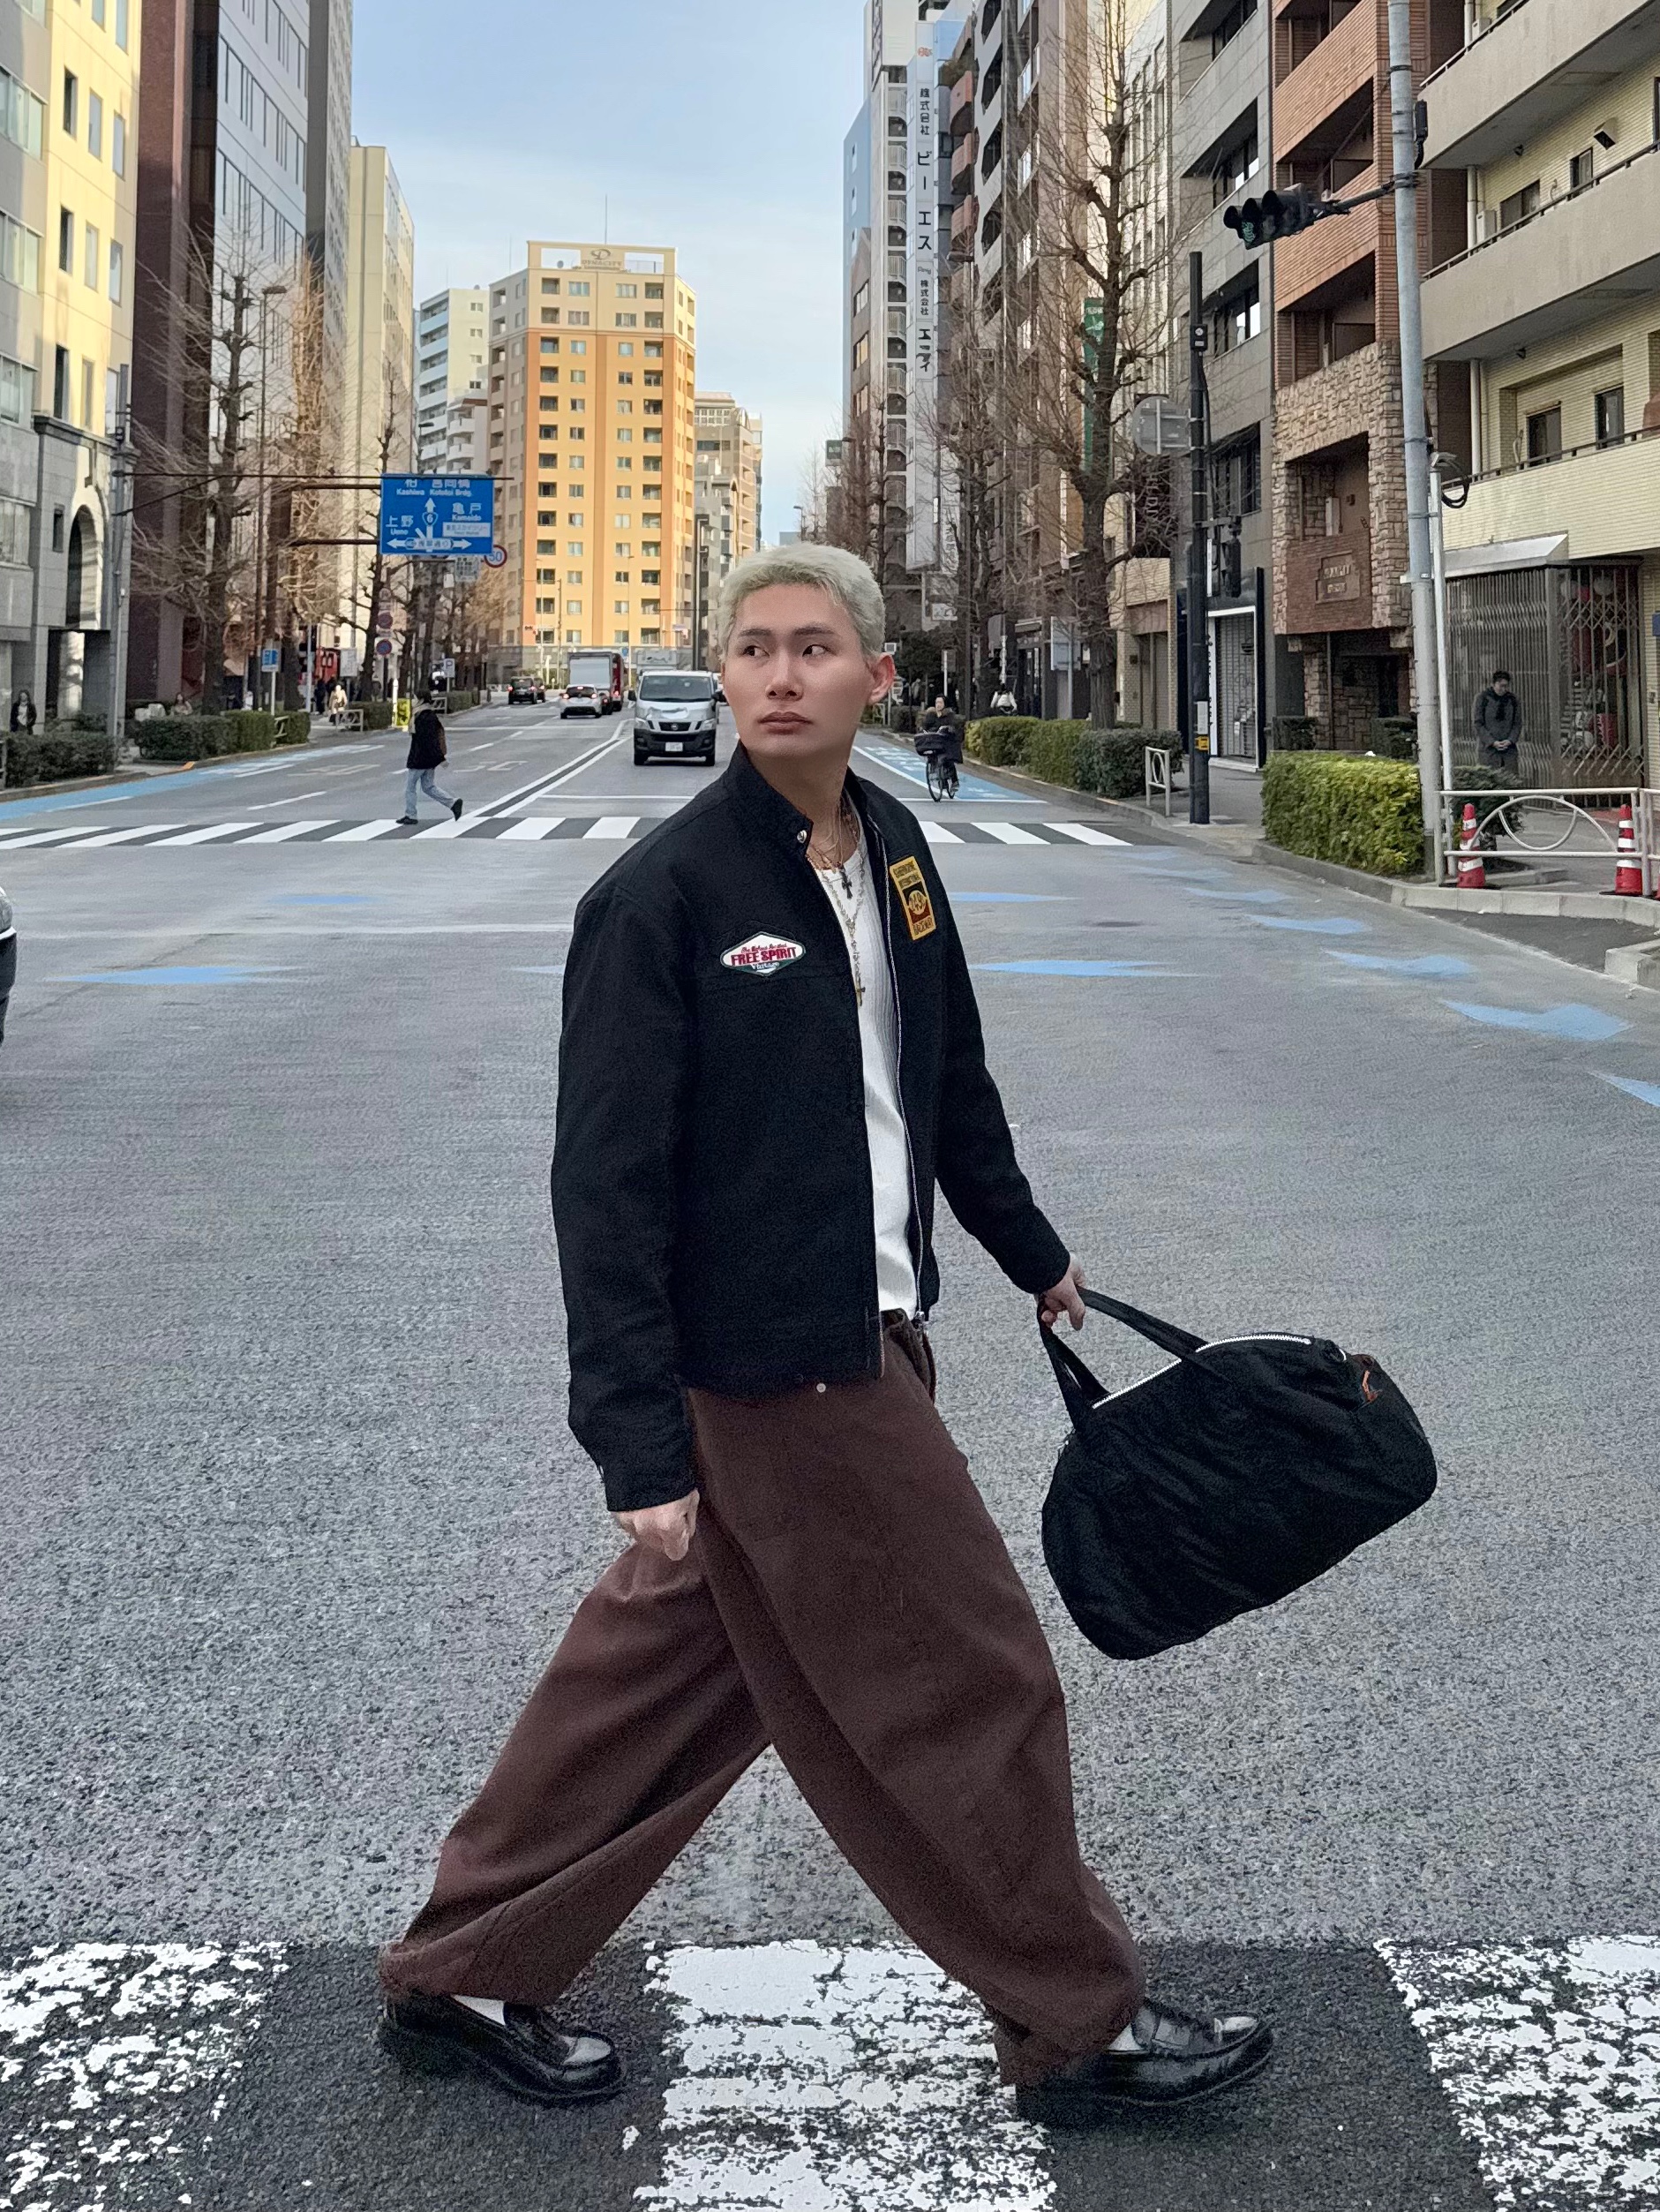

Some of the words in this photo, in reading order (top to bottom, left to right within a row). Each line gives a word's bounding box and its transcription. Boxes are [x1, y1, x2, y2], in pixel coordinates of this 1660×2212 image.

[918, 151, 932, 250] ビーエス
[386, 515, 414, 527] 上野
[426, 513, 433, 523] 6
[731, 952, 760, 967] FREE
[761, 946, 797, 961] SPIRIT
